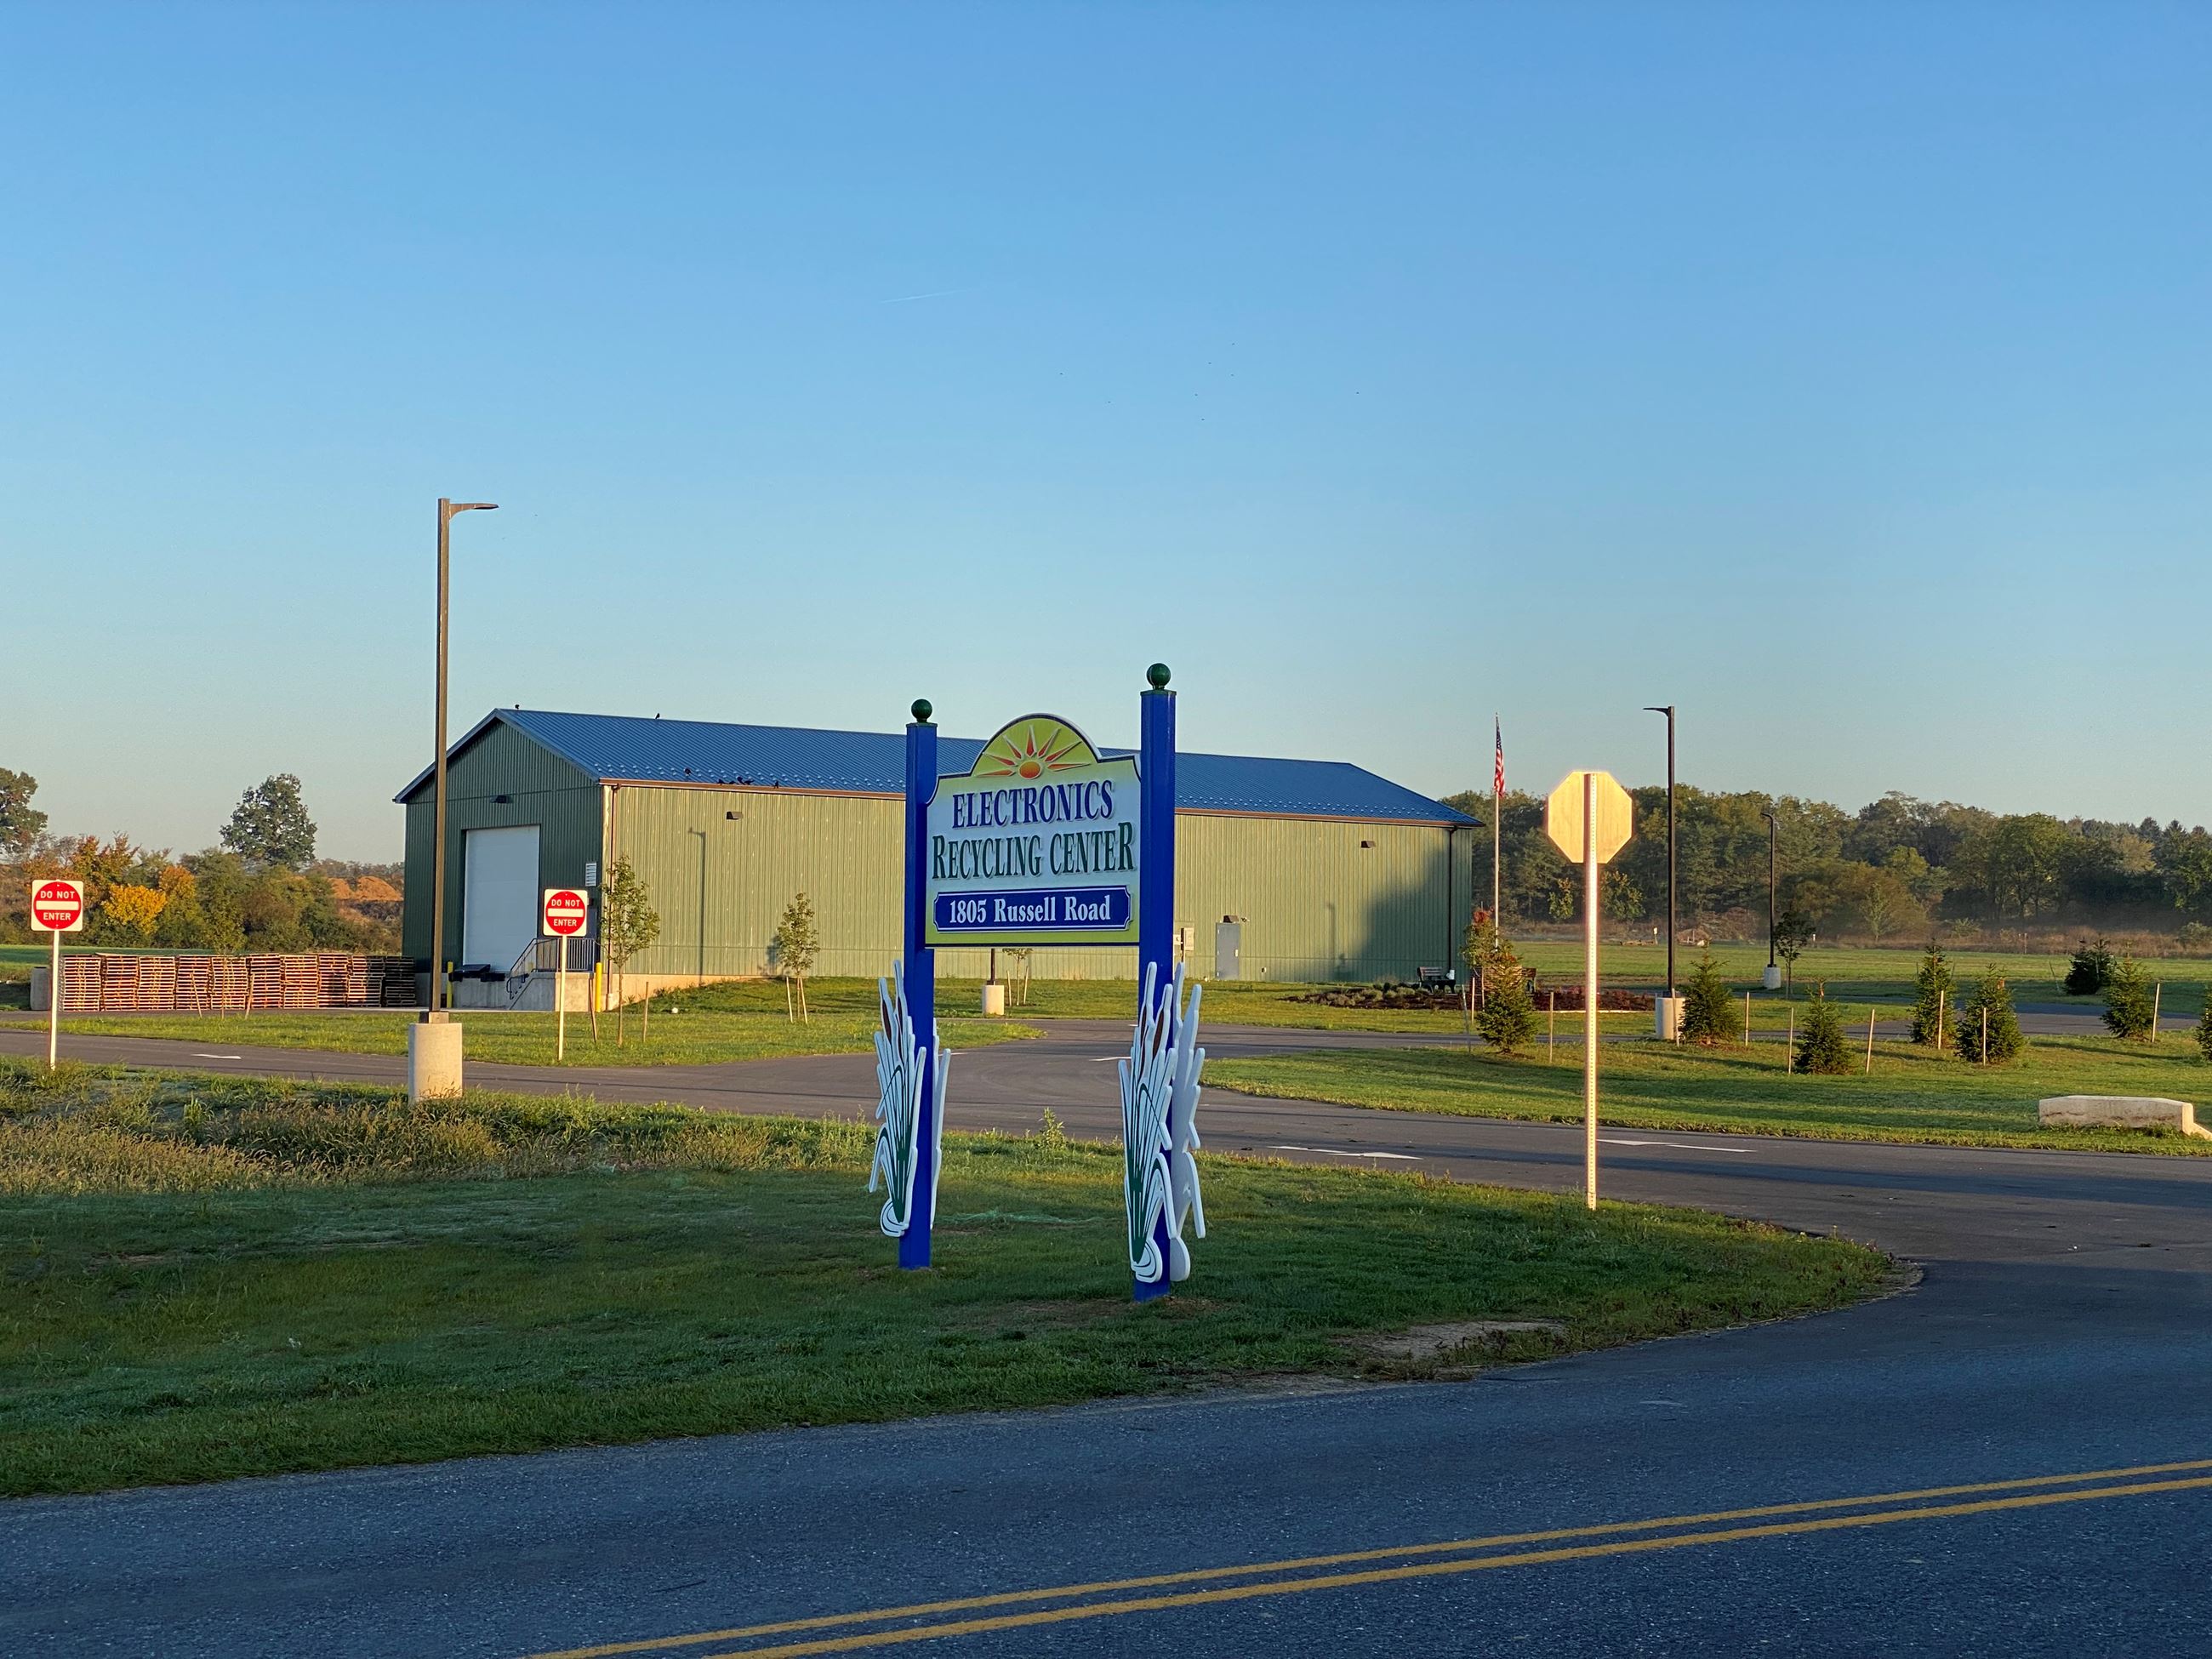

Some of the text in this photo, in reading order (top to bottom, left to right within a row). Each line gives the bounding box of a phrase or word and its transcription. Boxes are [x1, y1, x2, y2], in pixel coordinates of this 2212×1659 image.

[951, 779, 1114, 829] ELECTRONICS
[932, 822, 1134, 880] RECYCLING CENTER
[949, 895, 1111, 923] 1805 Russell Road
